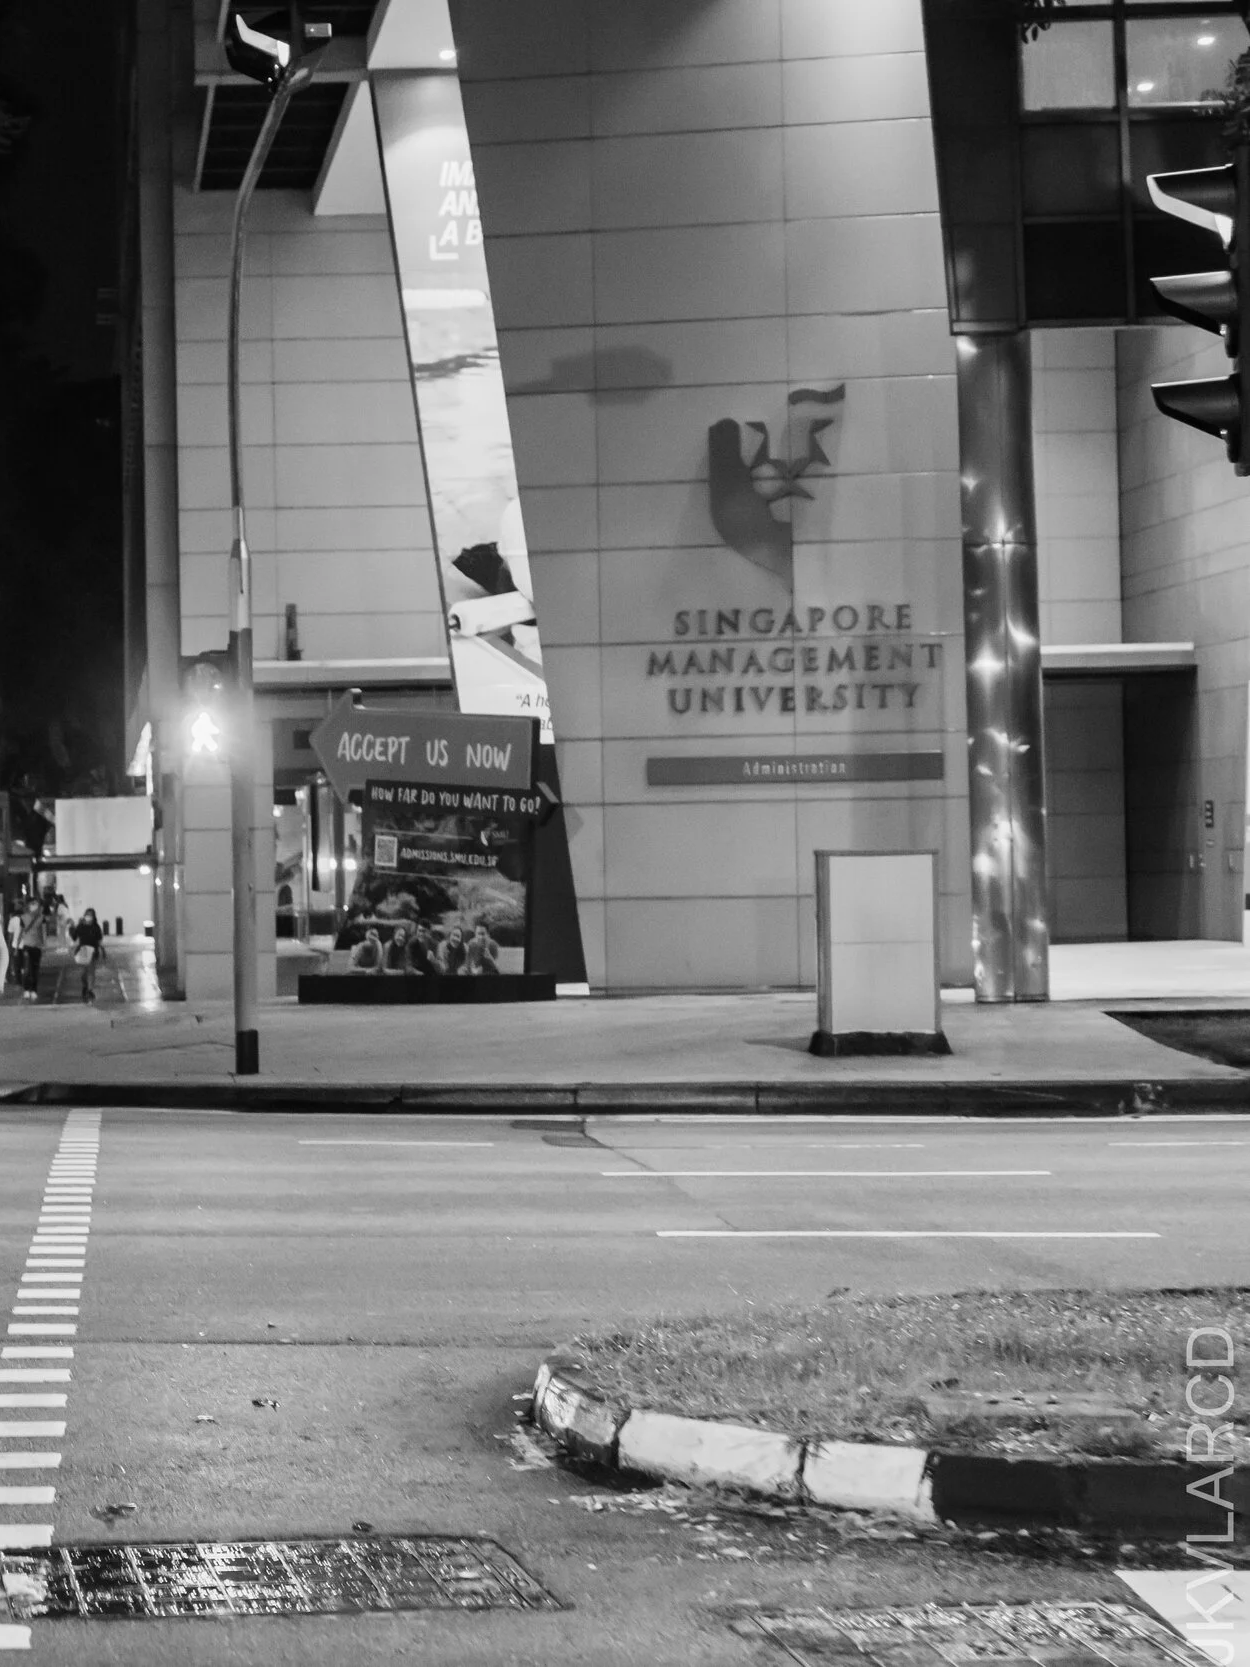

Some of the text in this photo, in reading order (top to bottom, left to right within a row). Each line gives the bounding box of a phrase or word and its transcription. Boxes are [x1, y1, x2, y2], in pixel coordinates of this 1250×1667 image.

[438, 219, 459, 247] A
[674, 604, 912, 636] SINGAPORE
[646, 642, 944, 676] MANAGEMENT
[667, 683, 923, 714] UNIVERSITY
[337, 731, 512, 771] ACCEPT US NOW
[742, 760, 847, 777] Administration
[371, 786, 395, 802] HOW
[398, 787, 418, 804] FAR
[421, 788, 436, 806] DO
[439, 790, 460, 808] YOU
[463, 792, 499, 811] WANT
[502, 795, 516, 813] TO
